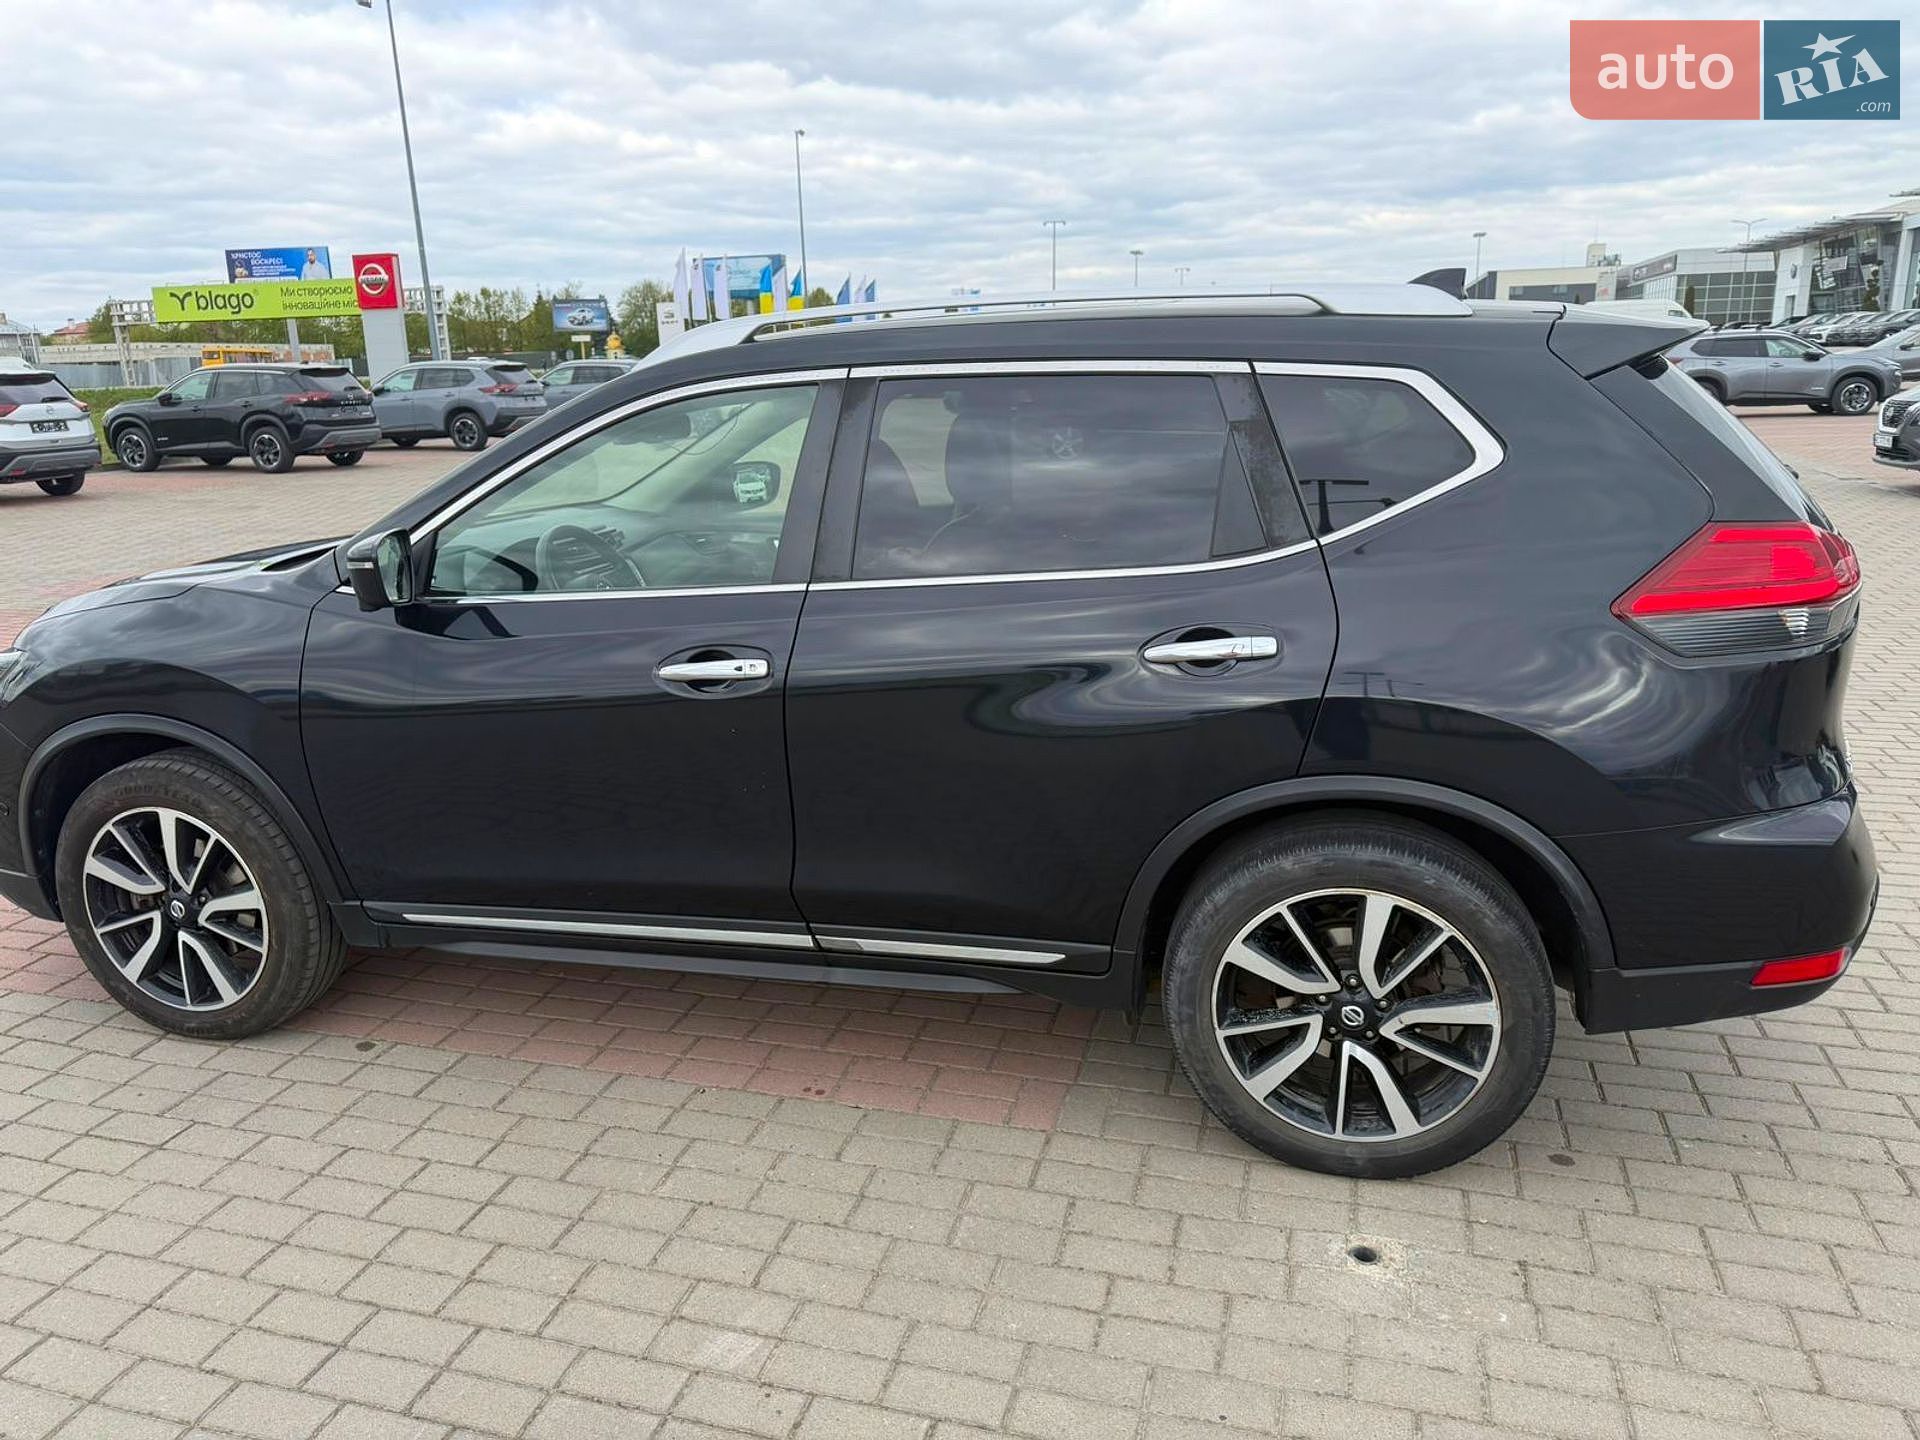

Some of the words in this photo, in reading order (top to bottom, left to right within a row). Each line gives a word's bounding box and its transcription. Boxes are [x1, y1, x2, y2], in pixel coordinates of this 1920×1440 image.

[280, 286, 296, 297] Ми
[296, 285, 353, 298] створюємо
[195, 291, 254, 314] blago
[282, 298, 341, 311] інноваційне
[342, 297, 359, 308] міс
